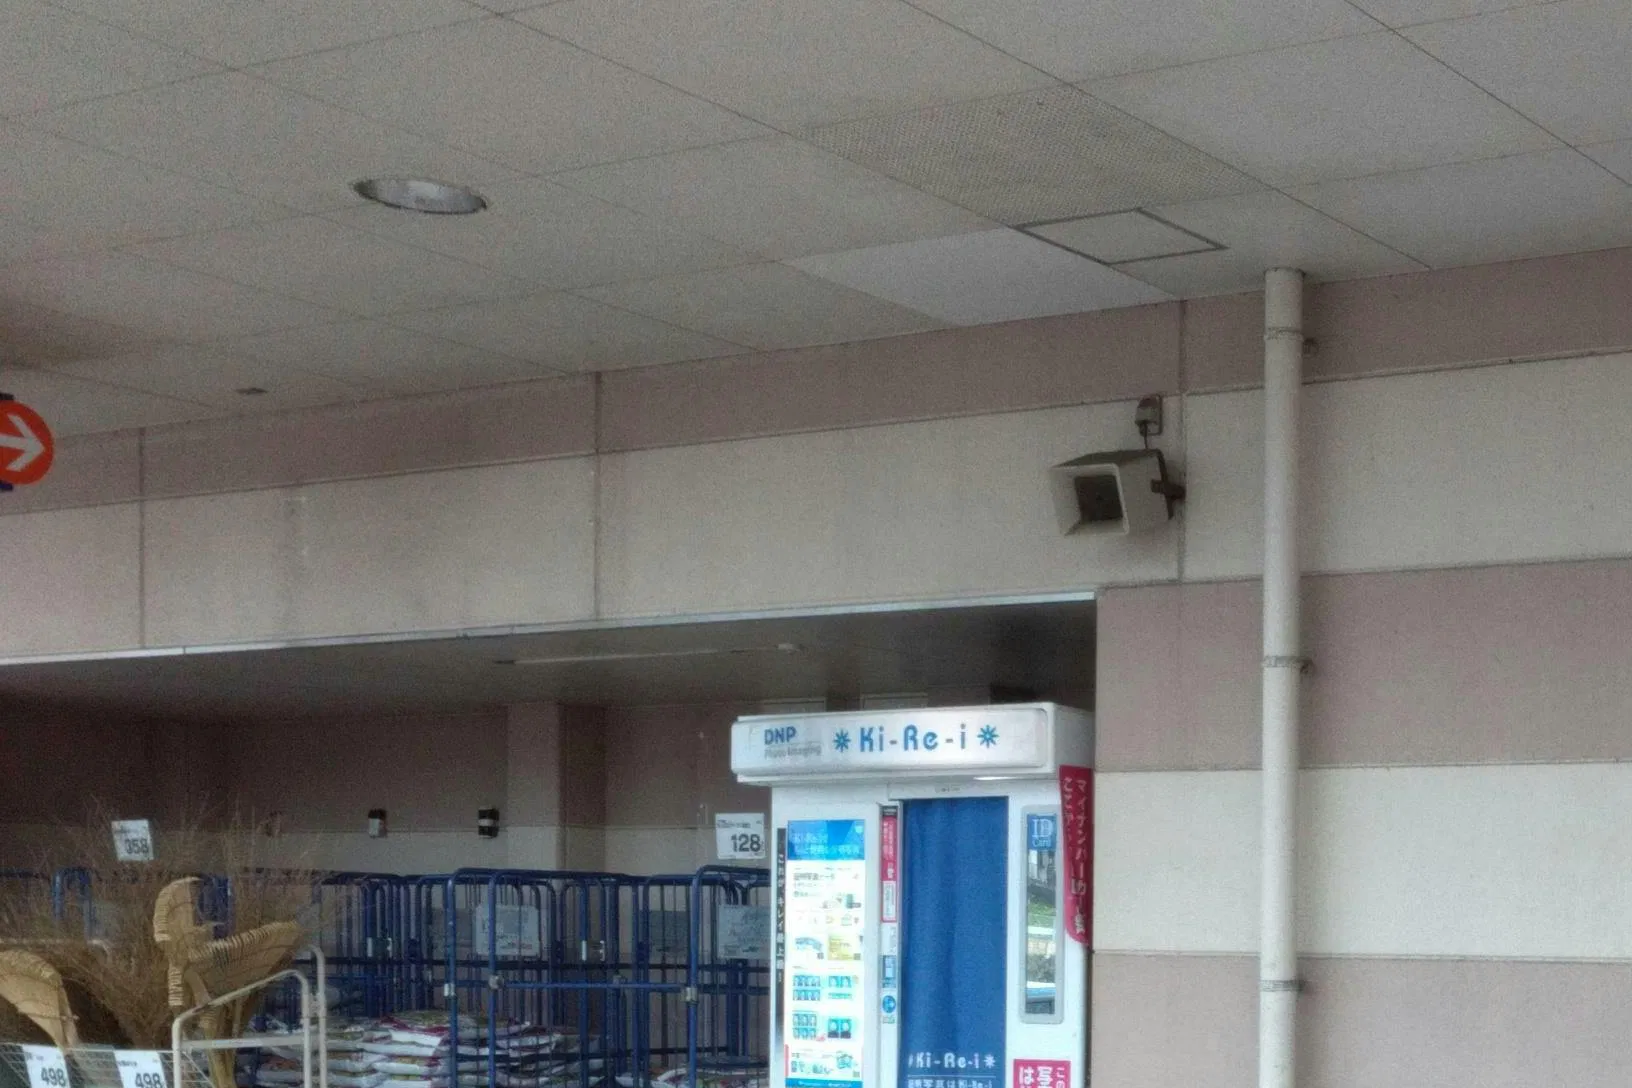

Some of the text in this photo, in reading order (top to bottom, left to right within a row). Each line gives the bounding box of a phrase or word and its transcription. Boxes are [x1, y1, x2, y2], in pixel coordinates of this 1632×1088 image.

[764, 726, 797, 745] DNP
[1031, 819, 1054, 838] ID
[731, 834, 761, 852] 128
[41, 1067, 66, 1087] 498
